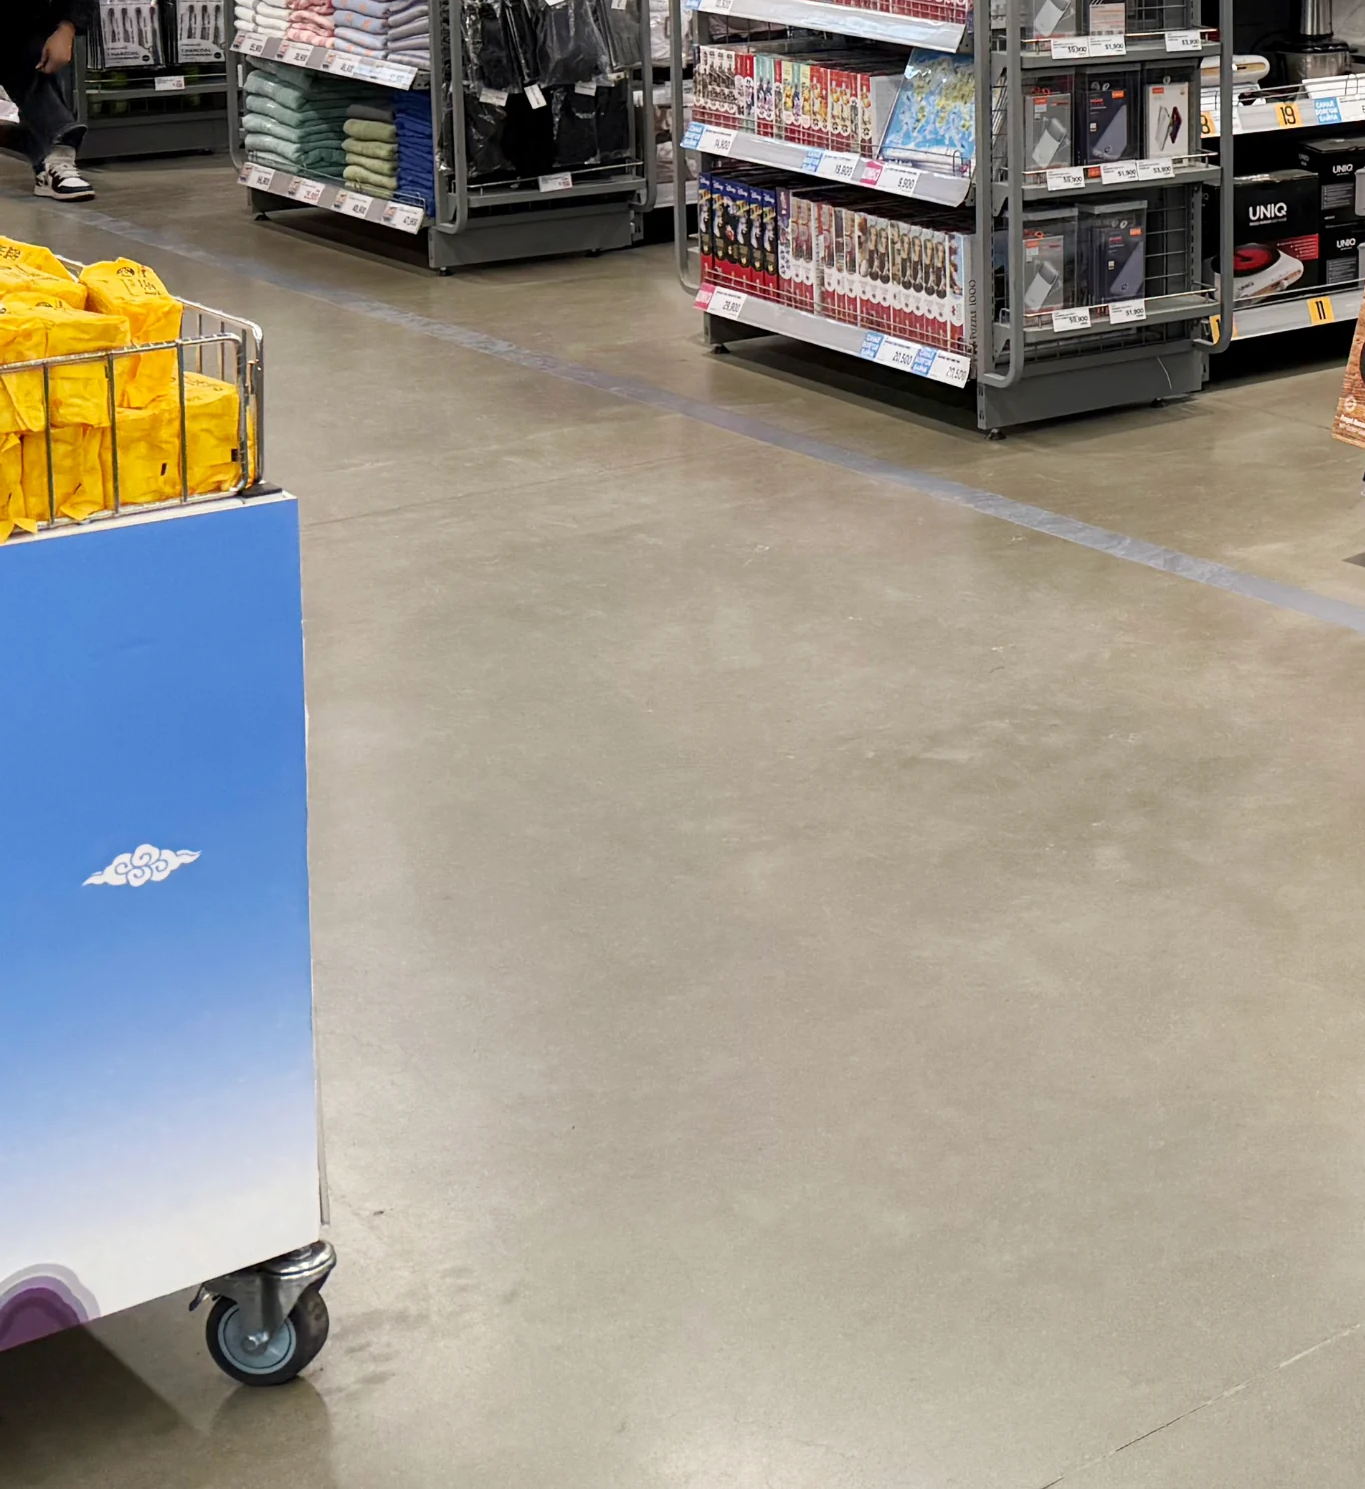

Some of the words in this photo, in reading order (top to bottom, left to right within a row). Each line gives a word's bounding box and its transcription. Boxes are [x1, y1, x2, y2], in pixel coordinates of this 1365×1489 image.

[1280, 106, 1297, 125] 19
[1332, 163, 1354, 174] UNIQ
[1249, 202, 1287, 221] UNIQ
[1315, 300, 1326, 321] 11
